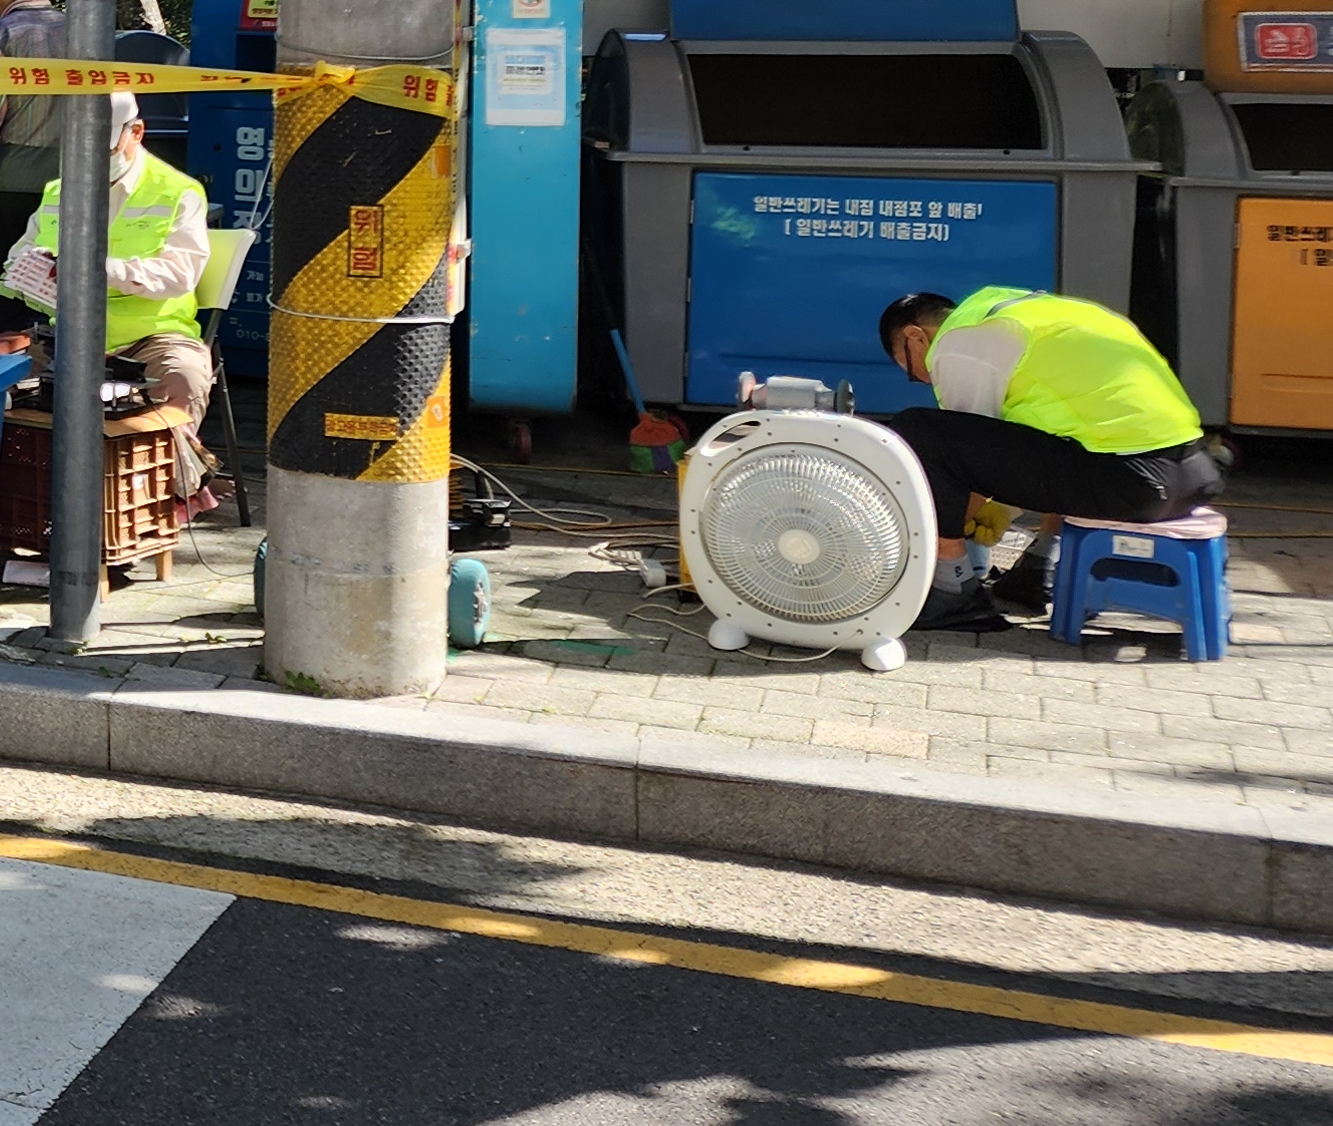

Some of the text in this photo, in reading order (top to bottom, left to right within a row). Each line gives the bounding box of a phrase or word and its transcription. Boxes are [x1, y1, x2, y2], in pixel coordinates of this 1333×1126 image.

[9, 66, 50, 85] 위험
[402, 74, 439, 102] 위험
[753, 195, 840, 215] 일반쓰레기는
[845, 199, 874, 216] 내집
[353, 208, 379, 272] 위험
[1267, 224, 1333, 243] 일반쓰레
